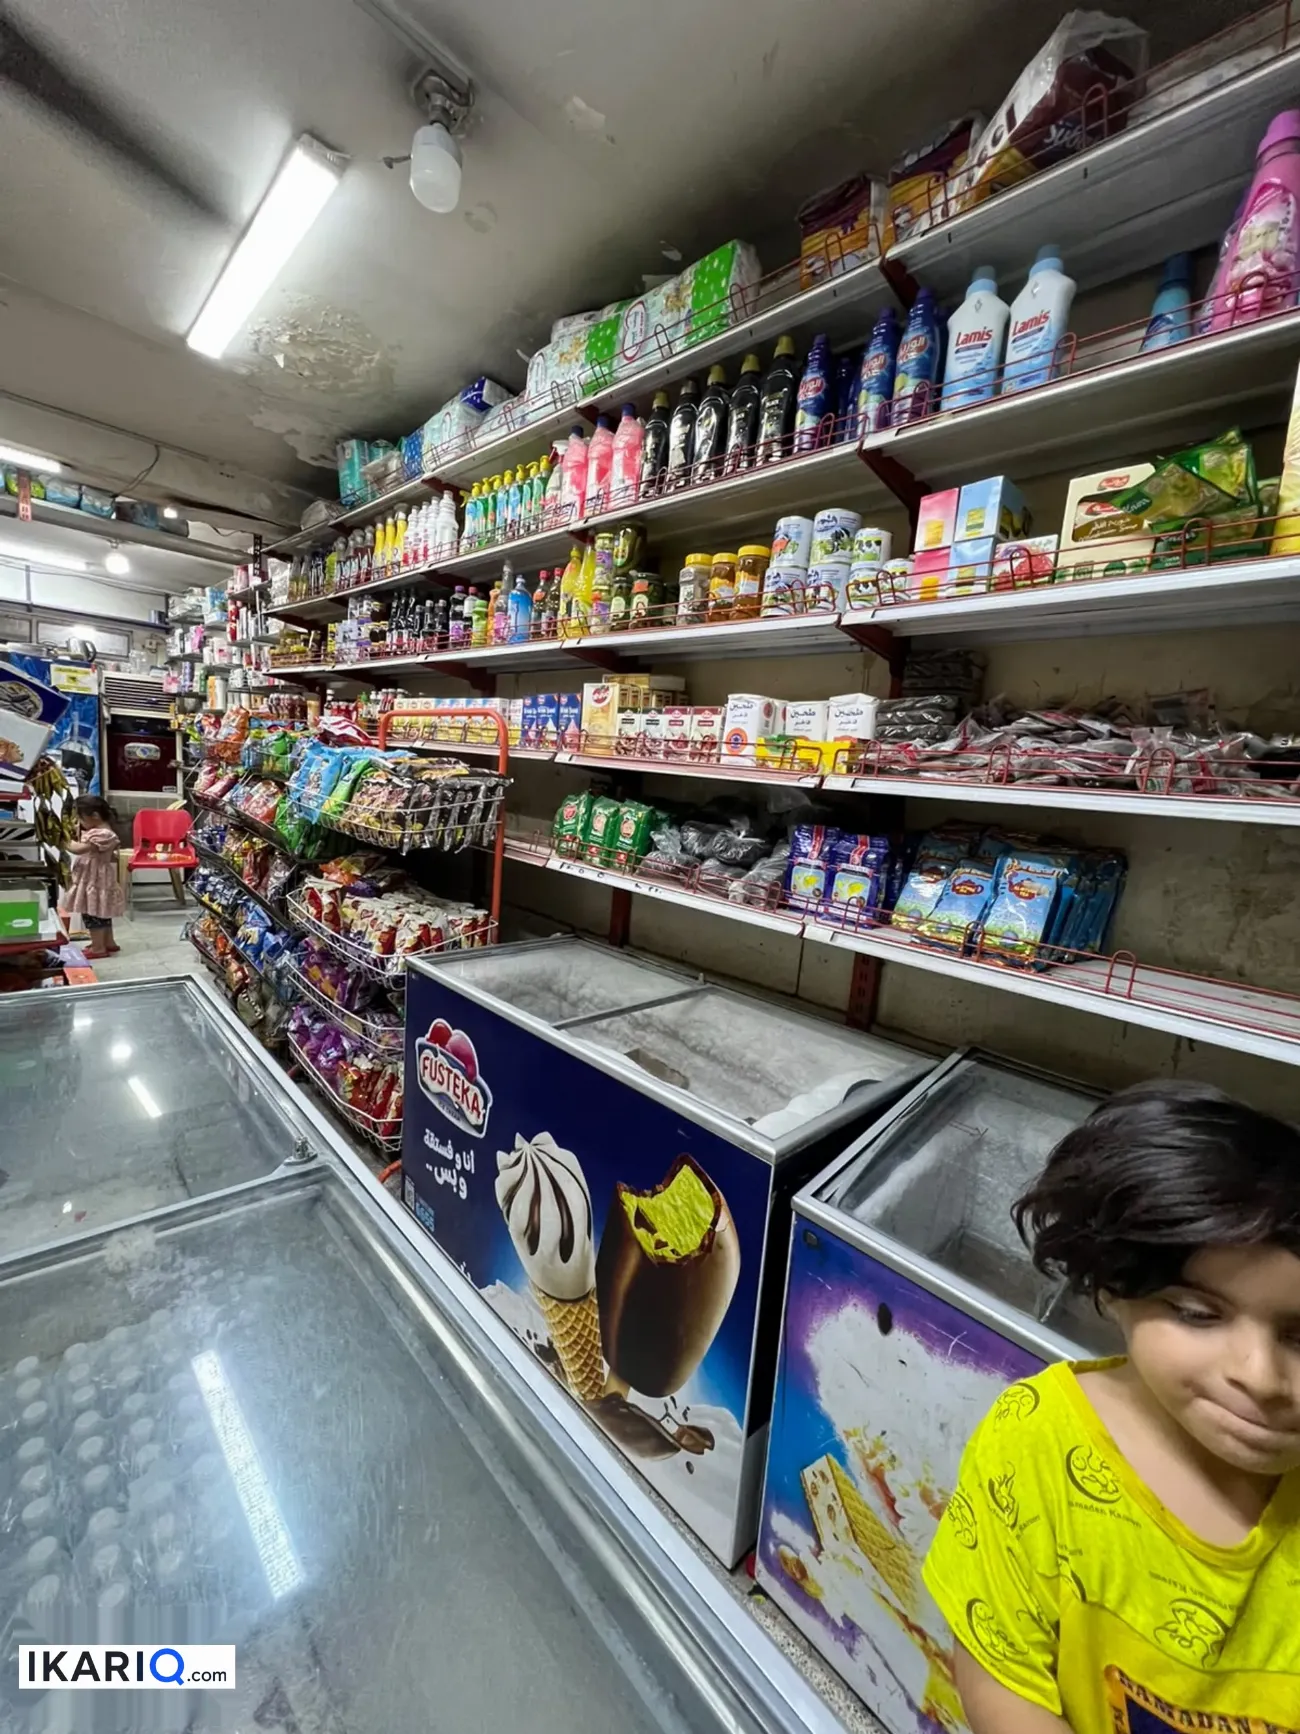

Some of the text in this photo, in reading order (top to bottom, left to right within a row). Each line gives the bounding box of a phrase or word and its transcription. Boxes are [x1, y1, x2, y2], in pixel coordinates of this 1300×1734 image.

[955, 326, 993, 348] Lamis
[1012, 309, 1051, 337] Lamis
[421, 1056, 483, 1120] FUSTEKA
